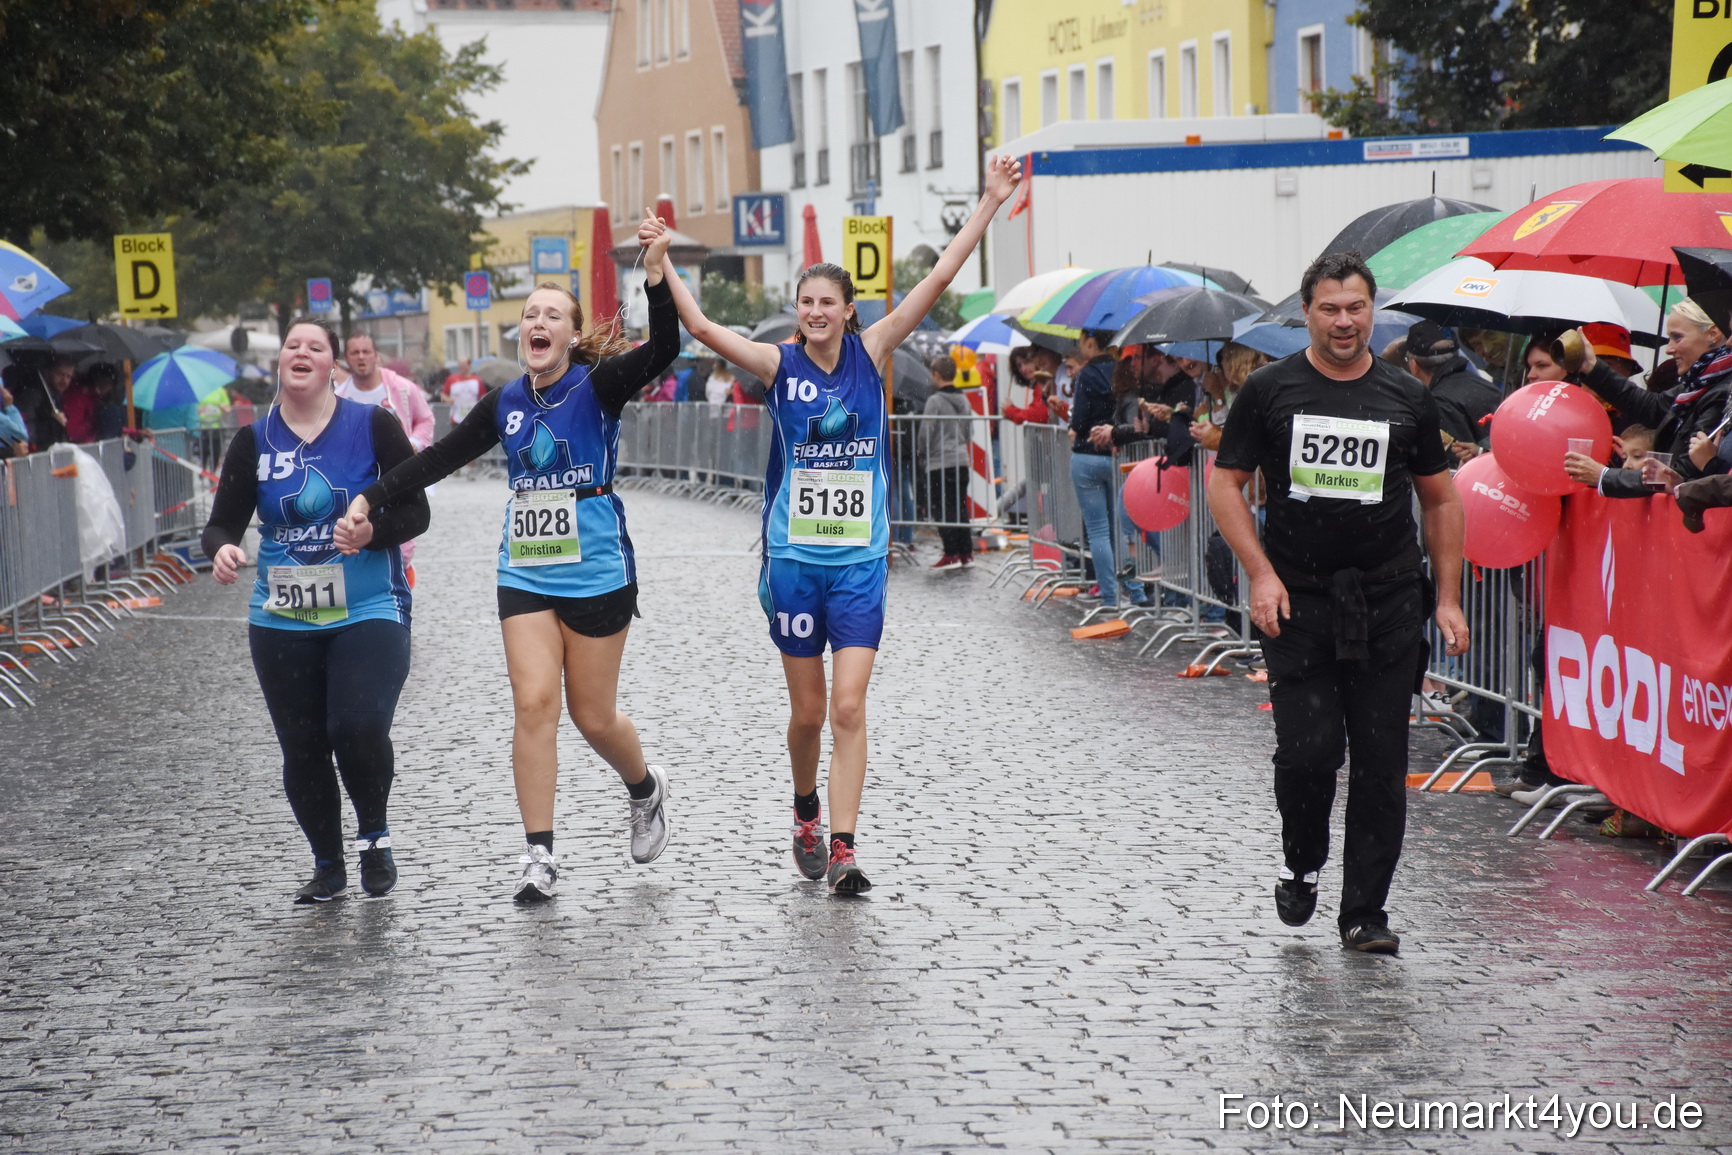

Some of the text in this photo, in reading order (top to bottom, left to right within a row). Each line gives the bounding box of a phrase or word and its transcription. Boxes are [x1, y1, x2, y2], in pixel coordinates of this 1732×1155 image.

[738, 199, 780, 237] KL
[848, 219, 888, 235] Block
[121, 237, 166, 253] Block
[856, 241, 880, 281] D
[131, 260, 160, 300] D
[1463, 283, 1490, 291] DKV
[786, 377, 818, 402] 10
[505, 410, 525, 436] 8
[1301, 433, 1379, 468] 5280
[256, 451, 296, 482] 45
[813, 460, 849, 468] BASKETS
[827, 472, 866, 483] BOCK
[1315, 472, 1360, 488] Markus
[798, 487, 865, 517] 5138
[514, 507, 571, 538] 5028
[816, 523, 845, 535] Luisa
[520, 544, 563, 557] Christina
[296, 567, 336, 577] BOCK
[274, 581, 336, 609] 5011
[776, 611, 815, 639] 10
[1682, 674, 1732, 731] ener
